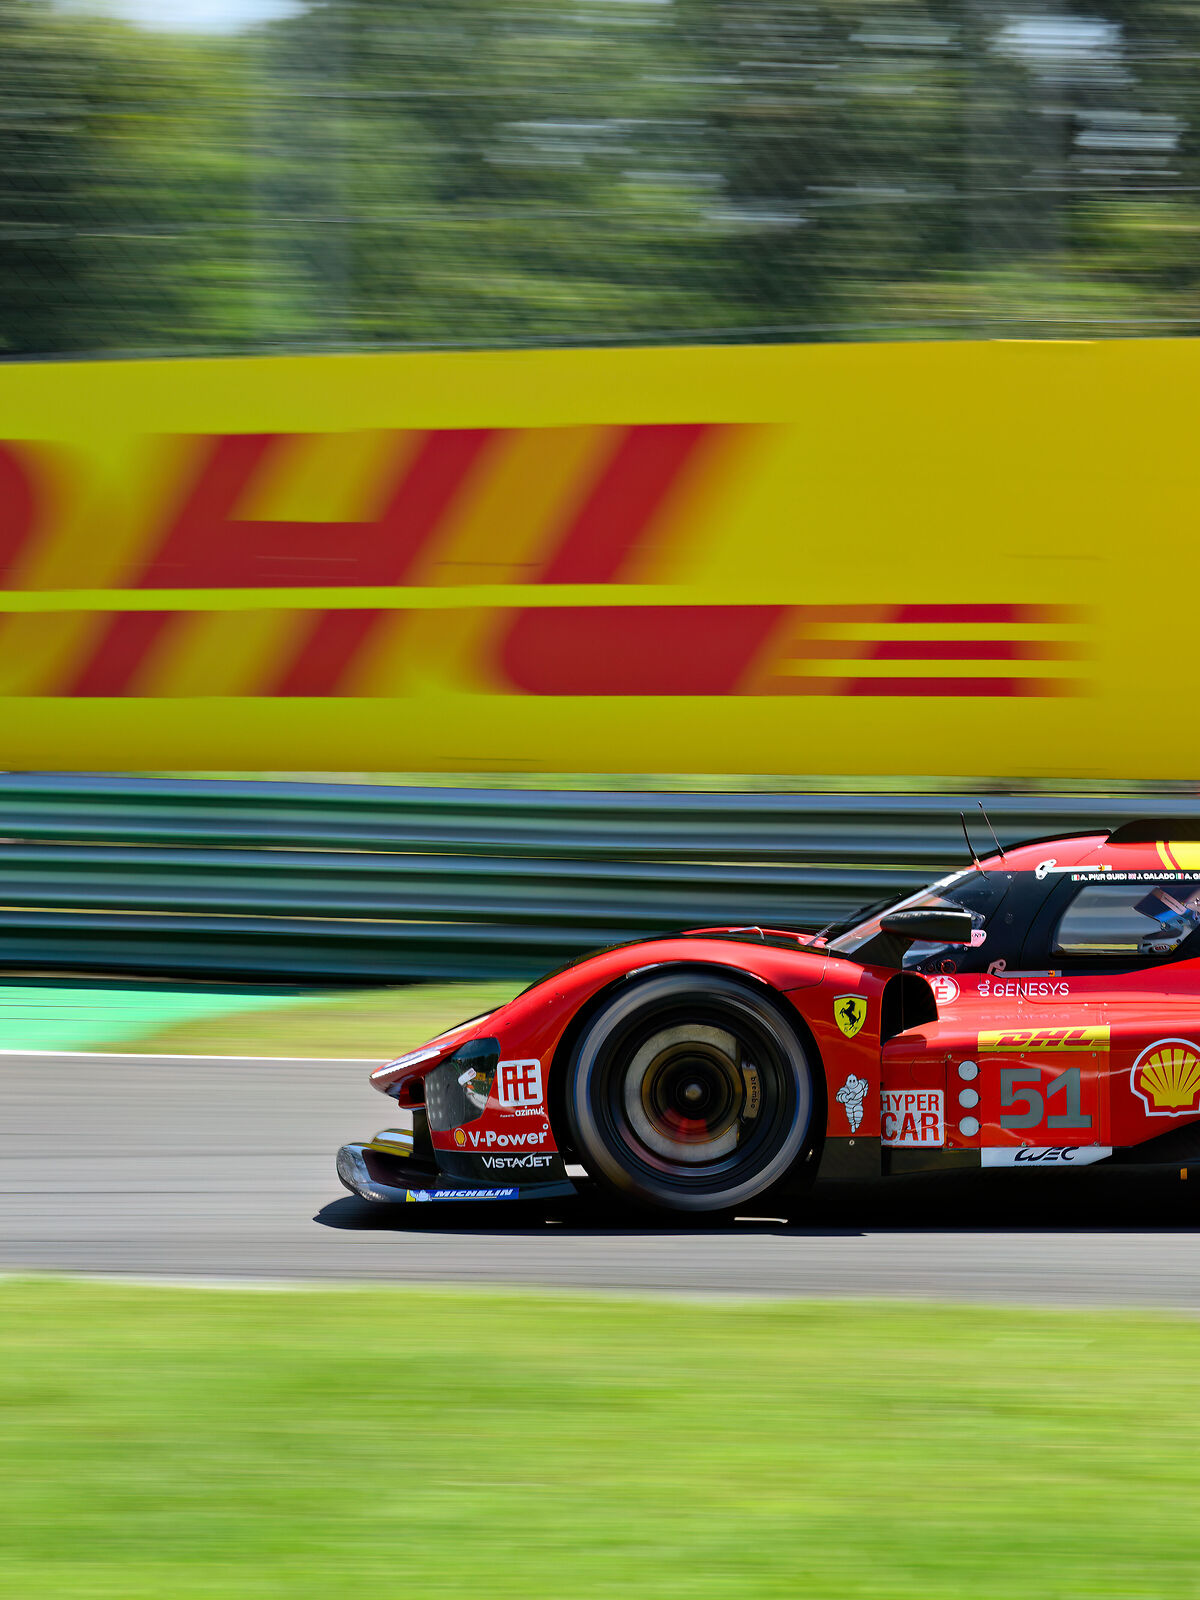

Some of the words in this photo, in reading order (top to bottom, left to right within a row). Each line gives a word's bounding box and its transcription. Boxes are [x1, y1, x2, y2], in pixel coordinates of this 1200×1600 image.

[0, 422, 790, 698] HL
[993, 983, 1070, 997] GENESYS
[995, 1029, 1094, 1047] DHL
[881, 1094, 940, 1112] HYPER
[1000, 1067, 1093, 1129] 51
[515, 1105, 545, 1117] azimut
[881, 1112, 941, 1142] CAR
[468, 1131, 547, 1148] V-Power
[482, 1152, 553, 1169] VISTAJET
[1014, 1147, 1080, 1161] WEC
[434, 1188, 514, 1198] MICHELIN
